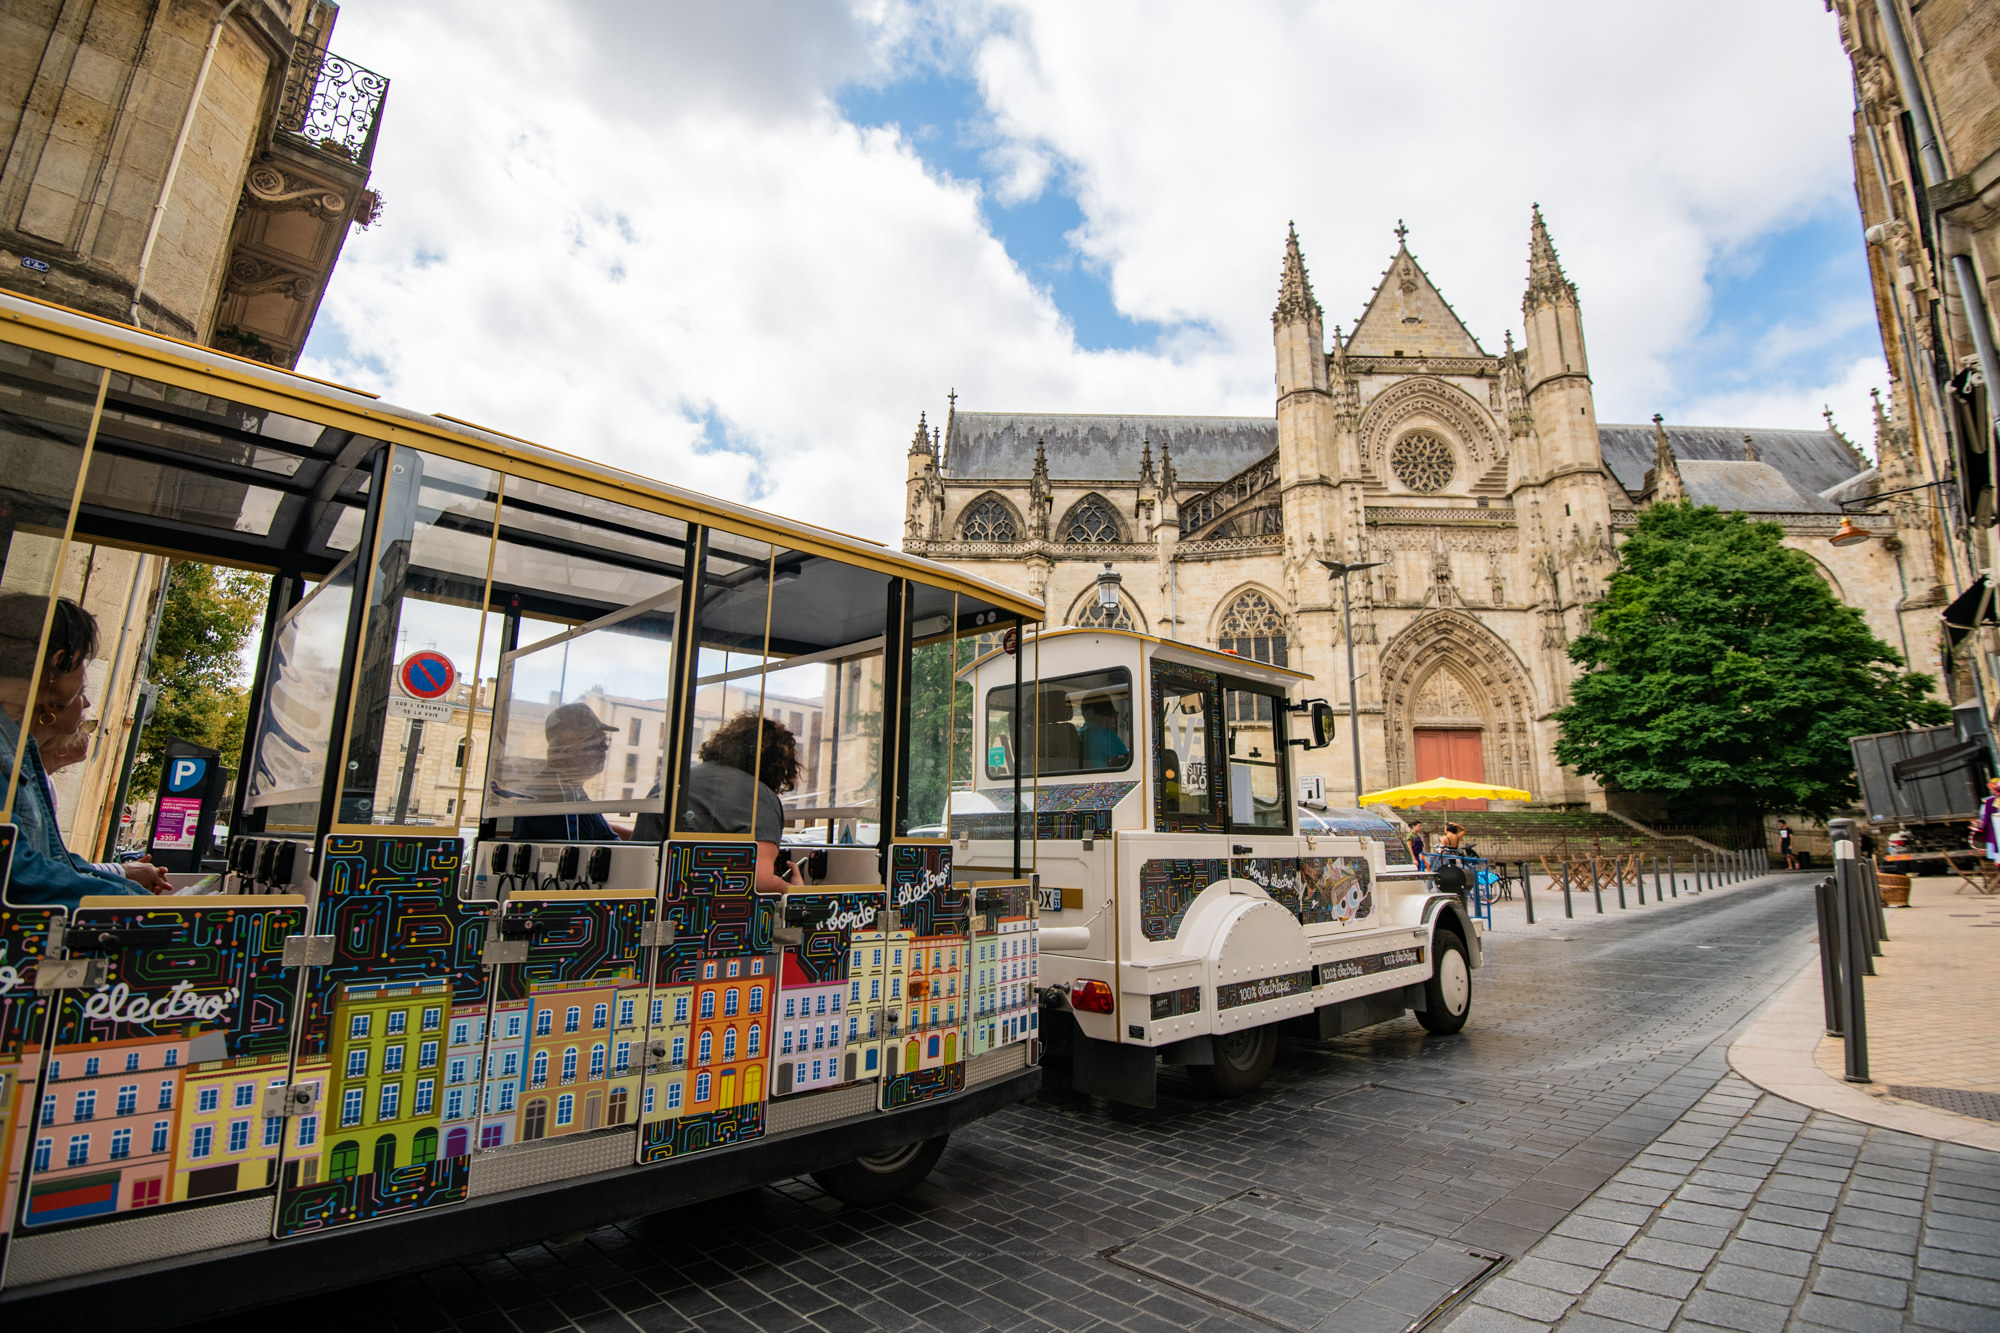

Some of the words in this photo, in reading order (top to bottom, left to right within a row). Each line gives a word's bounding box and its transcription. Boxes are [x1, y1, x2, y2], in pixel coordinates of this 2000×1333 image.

[410, 703, 448, 712] L'ENSEMBLE
[174, 761, 196, 785] P
[1383, 953, 1396, 966] 100%
[1323, 966, 1337, 980] 100%
[1240, 985, 1257, 1001] 100%
[1257, 978, 1291, 998] électrique
